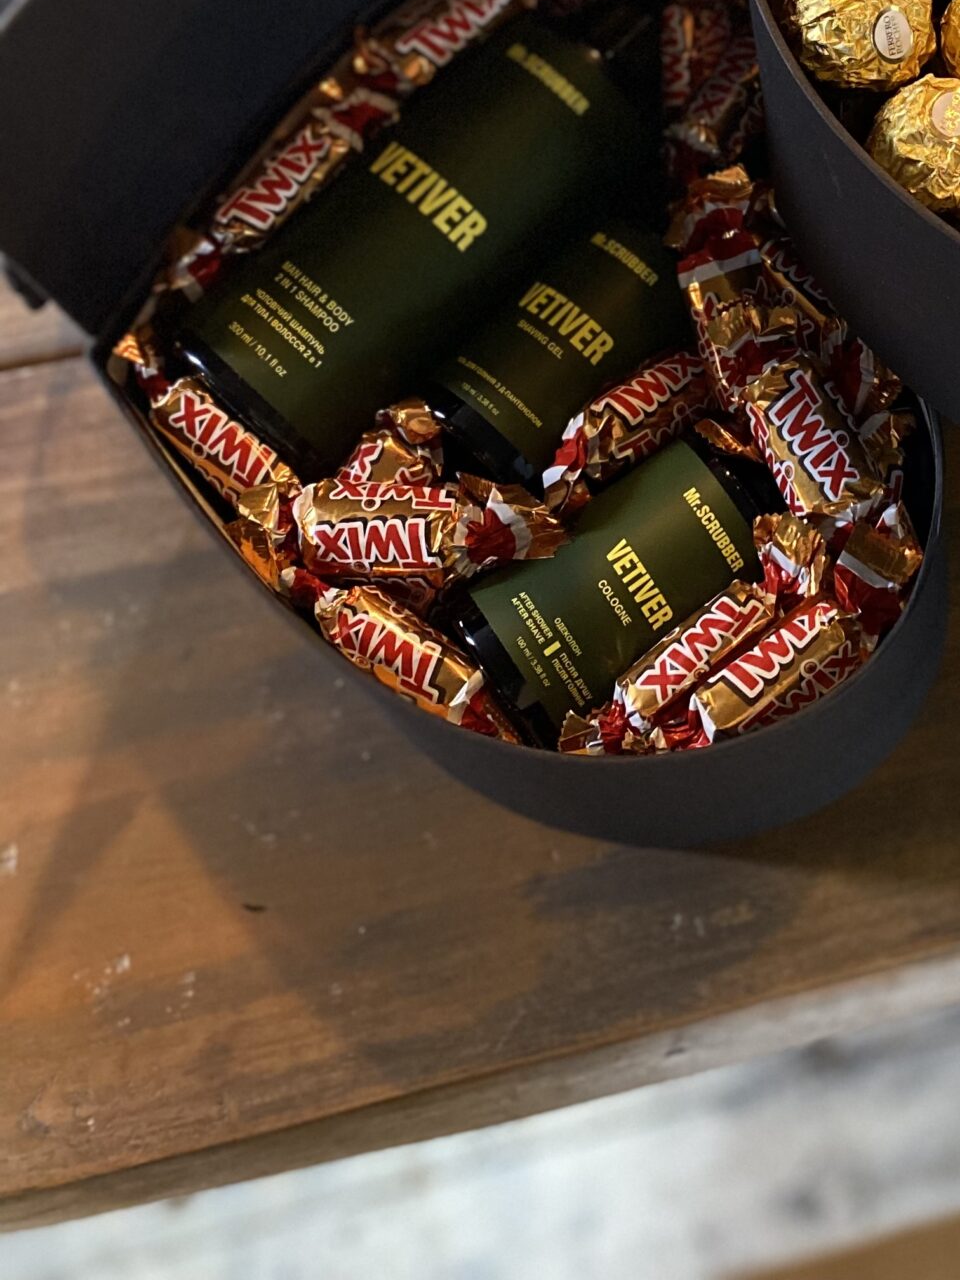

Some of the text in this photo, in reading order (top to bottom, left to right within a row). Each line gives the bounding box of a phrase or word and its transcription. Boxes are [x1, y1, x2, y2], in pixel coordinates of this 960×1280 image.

[884, 15, 895, 56] FERRERO
[369, 141, 488, 253] VETIVER
[274, 272, 284, 282] 2
[289, 285, 298, 294] 1
[295, 290, 340, 333] SHAMPOO
[299, 275, 322, 297] HAIR
[319, 294, 328, 303] &
[326, 300, 354, 327] BODY
[518, 281, 615, 367] VETIVER
[270, 319, 306, 353] ВОЛОССЯ
[303, 349, 312, 359] 2
[314, 360, 322, 368] 1
[289, 319, 325, 355] ШАМПУНЬ
[517, 319, 564, 360] SHAVING GEL
[275, 365, 287, 377] oz
[682, 486, 745, 573] Mr.SCRUBBER
[598, 579, 632, 627] COLOGNE
[605, 537, 674, 631] VETIVER
[511, 597, 546, 645] AFTER SHAVE
[519, 591, 554, 639] AFTER SHOWER
[554, 617, 582, 656] ОДЕКОЛОН
[516, 636, 527, 649] 100
[551, 658, 568, 680] ПІСЛЯ
[559, 652, 593, 700] ПІСЛЯ ДУШУ
